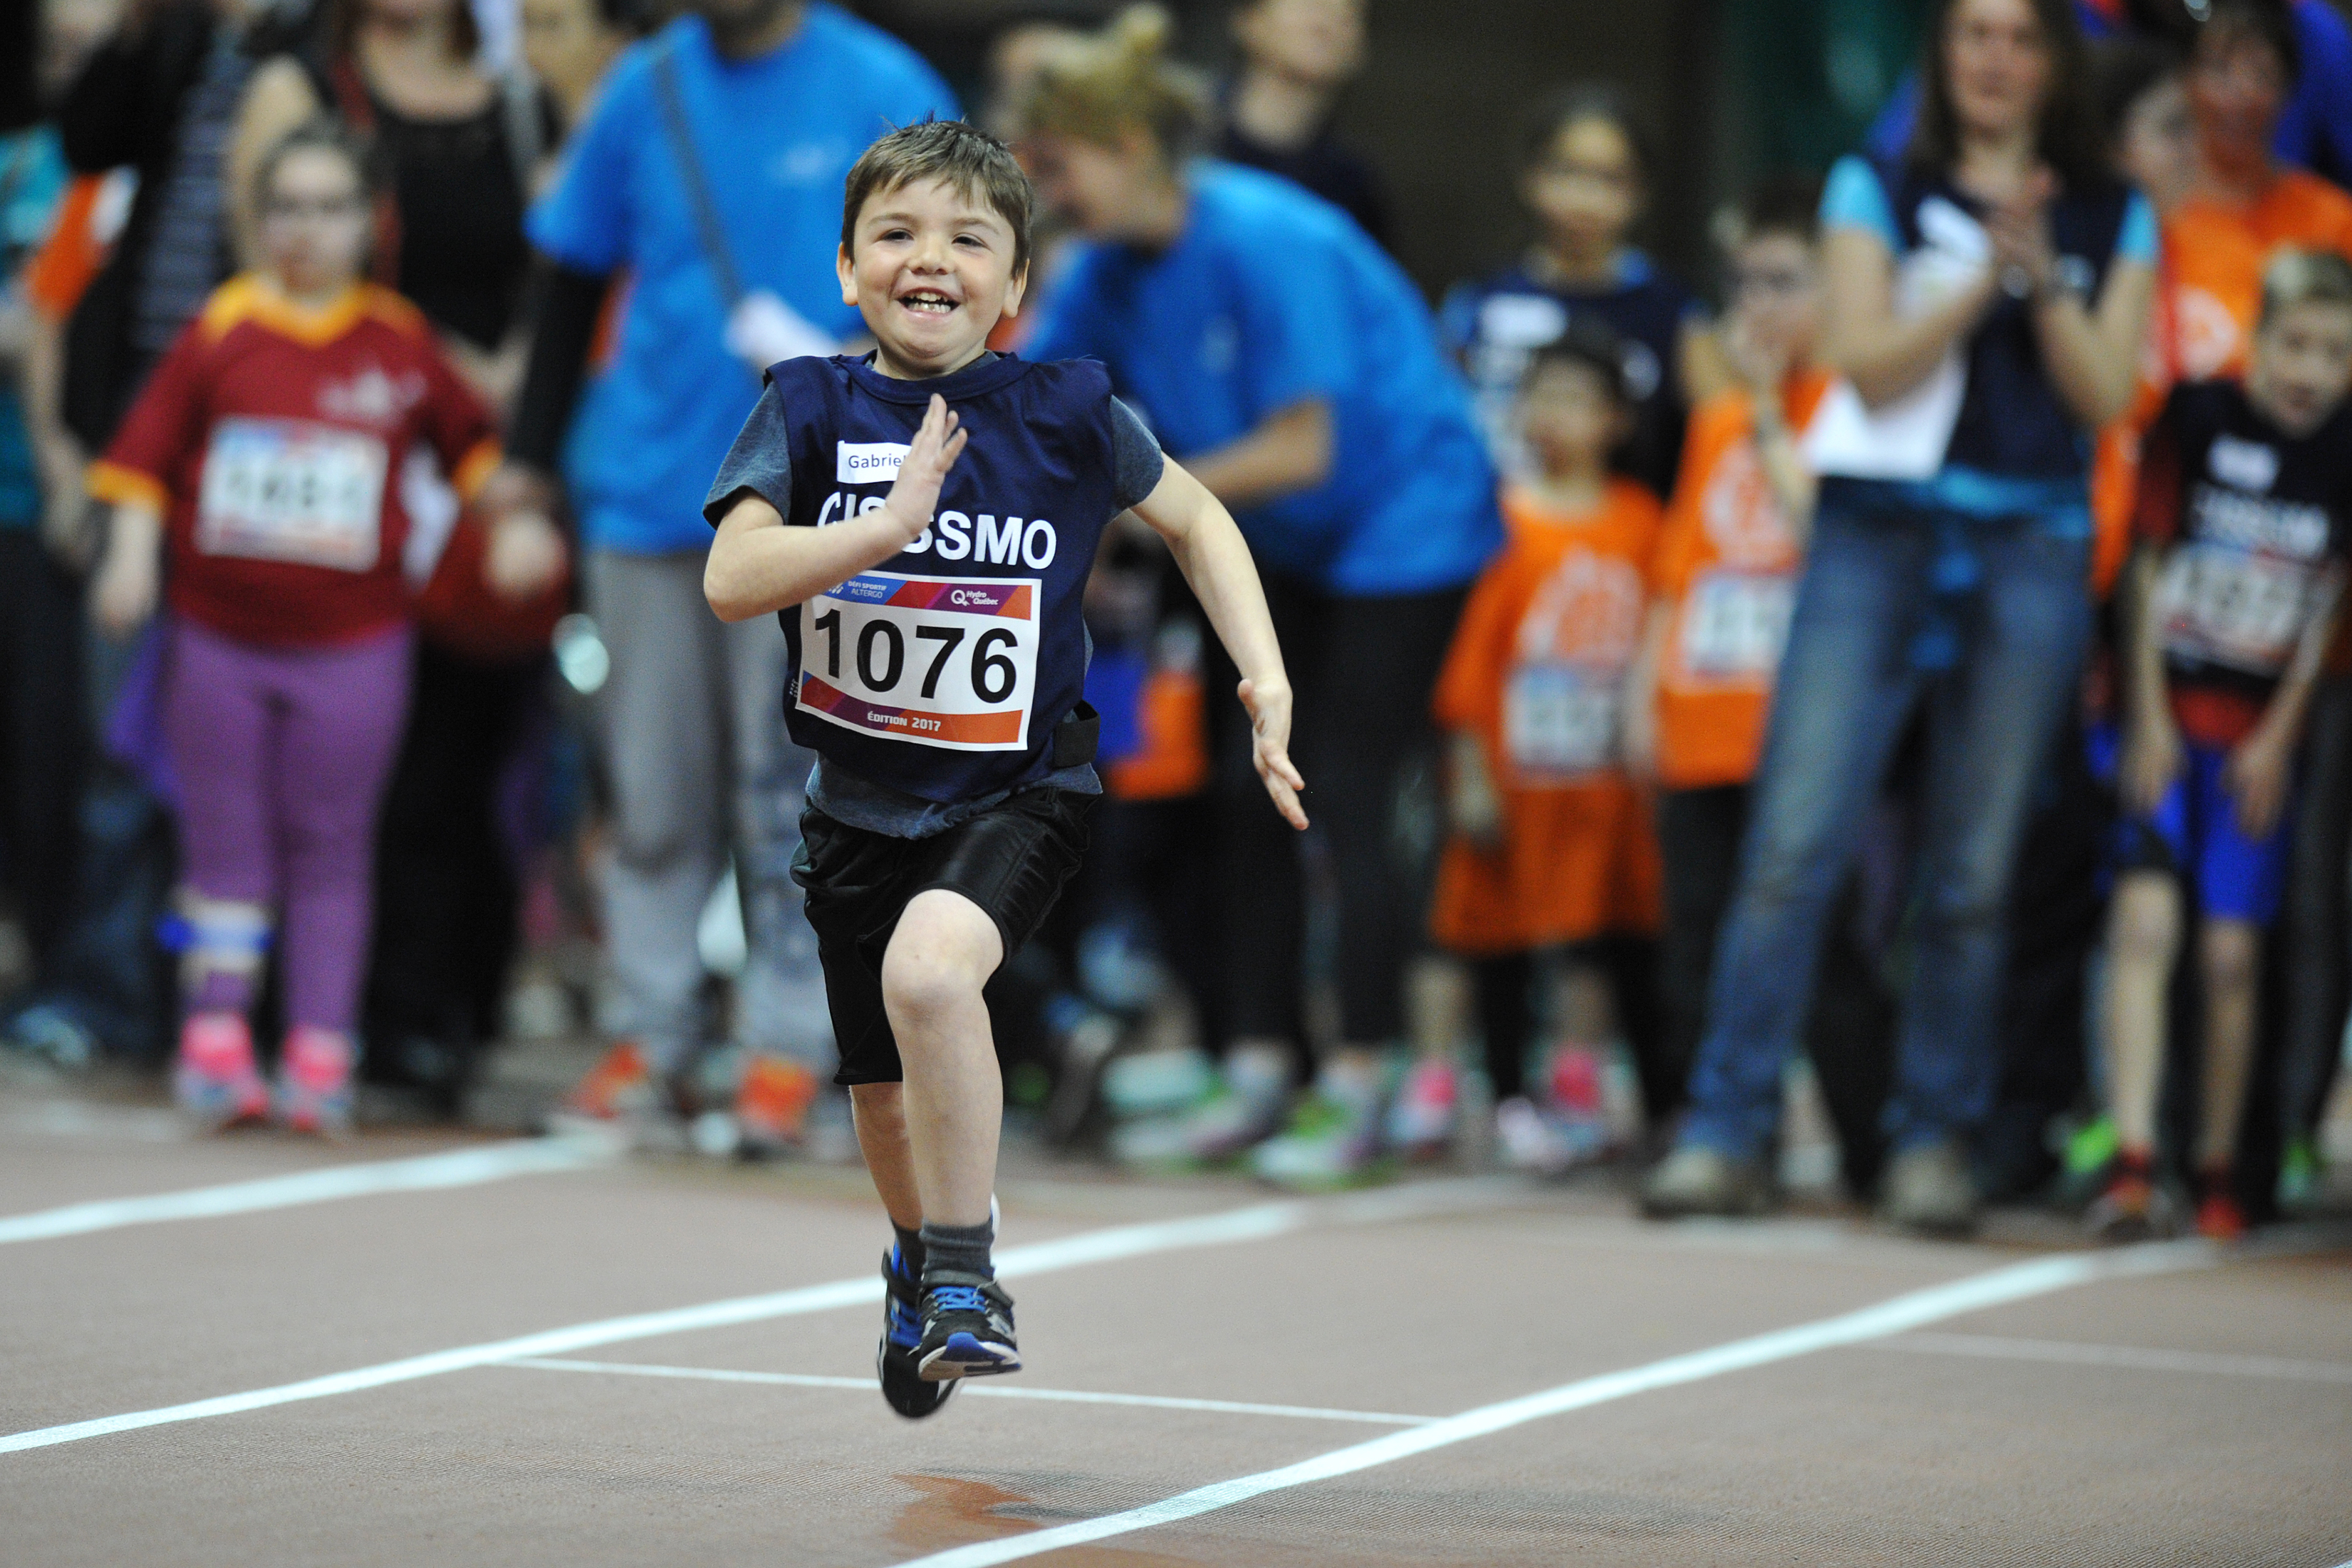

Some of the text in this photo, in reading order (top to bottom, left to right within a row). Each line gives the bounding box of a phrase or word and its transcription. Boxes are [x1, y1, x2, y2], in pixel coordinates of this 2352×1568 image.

[848, 453, 907, 469] Gabrie
[862, 583, 887, 591] SPORTIF
[851, 588, 883, 599] ALTERGO
[966, 590, 987, 599] Hydro
[972, 597, 999, 606] Québec
[814, 608, 1019, 704] 1076
[867, 711, 941, 732] ÉDITION 2017
